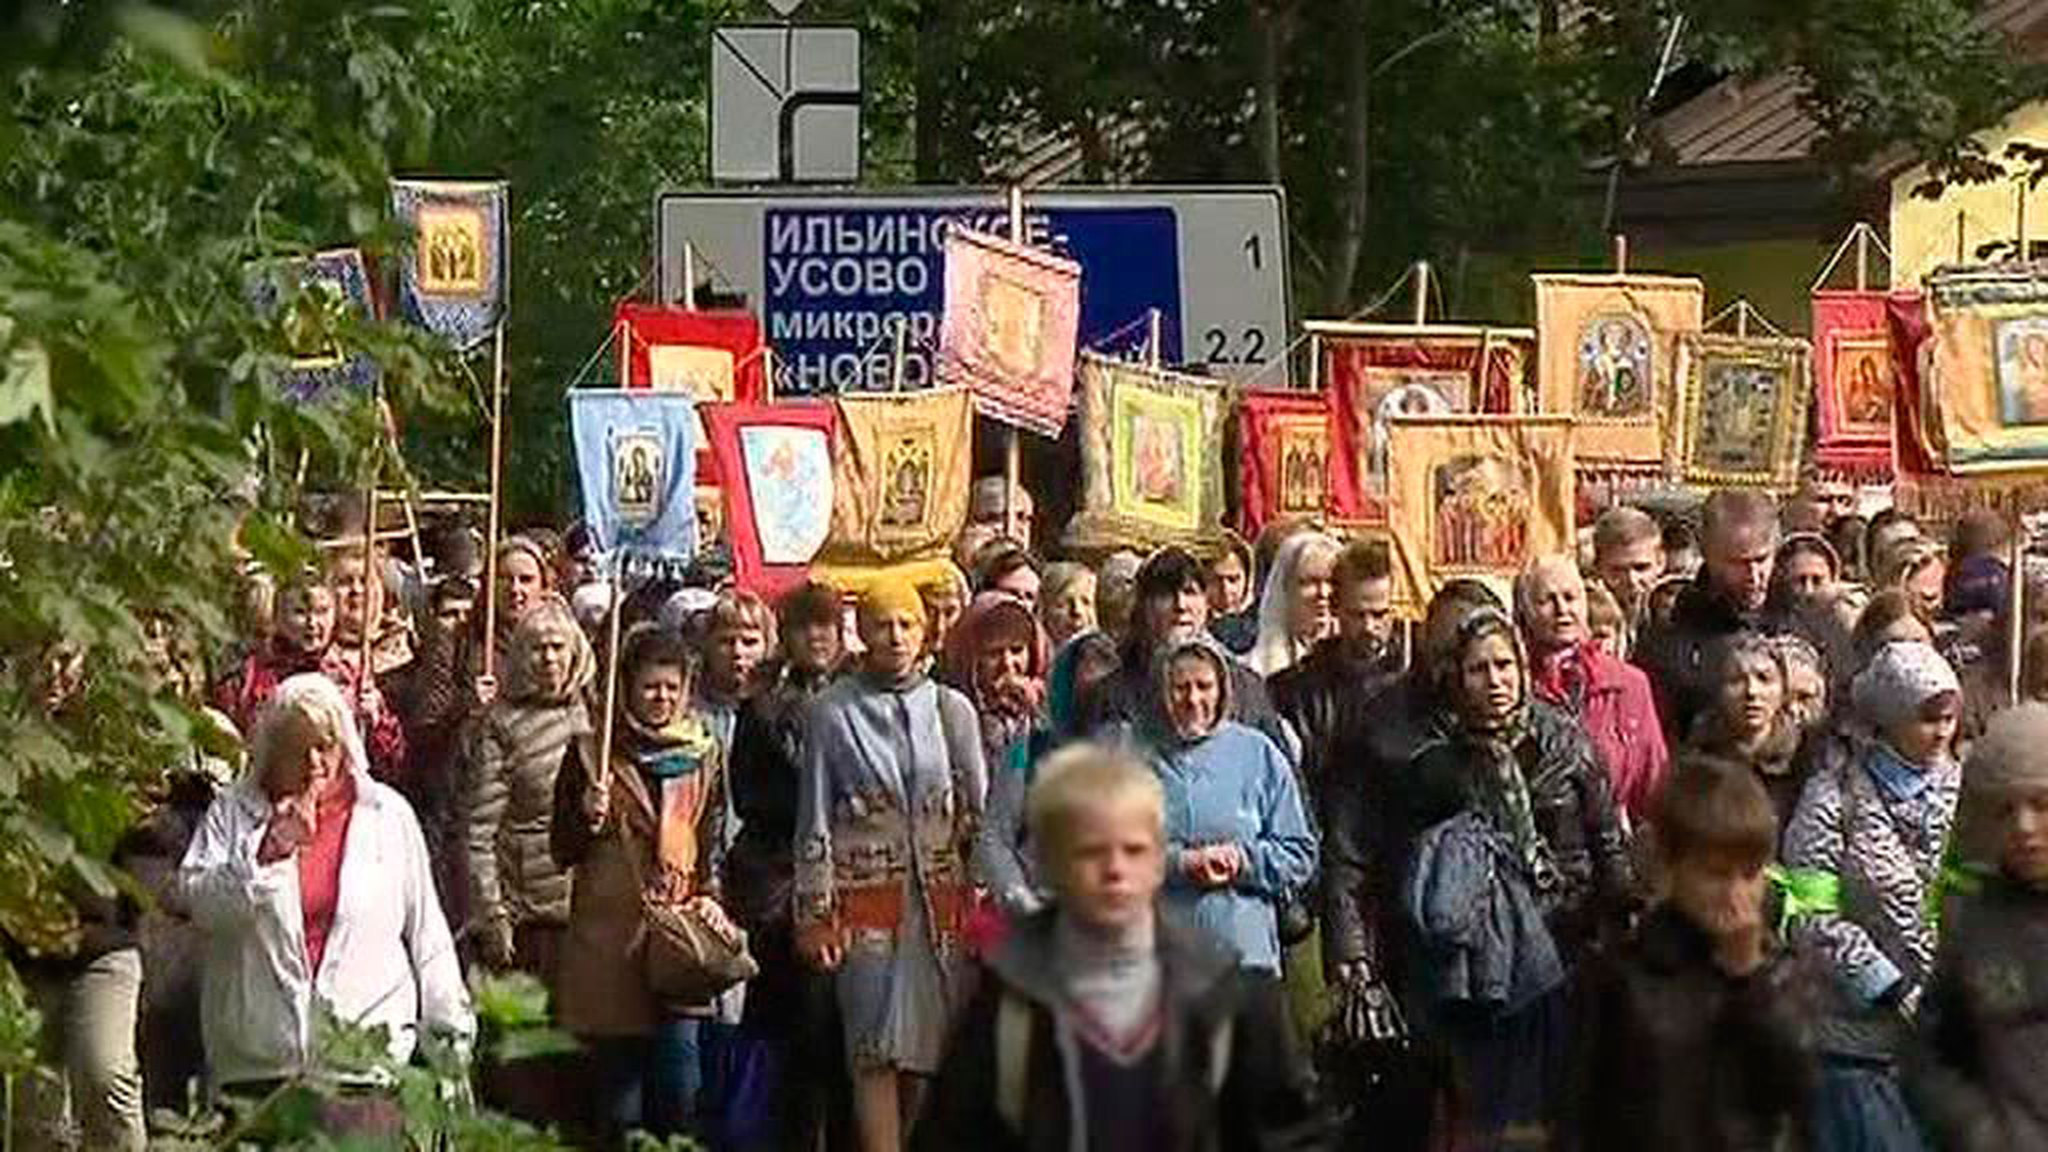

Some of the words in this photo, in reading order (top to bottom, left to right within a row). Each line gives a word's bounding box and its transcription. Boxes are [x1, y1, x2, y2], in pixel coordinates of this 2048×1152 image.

[1244, 234, 1260, 269] 1
[769, 256, 928, 295] УСОВО
[773, 311, 937, 347] микрор
[1205, 328, 1266, 364] 2.2
[774, 352, 943, 391] «НОВО
